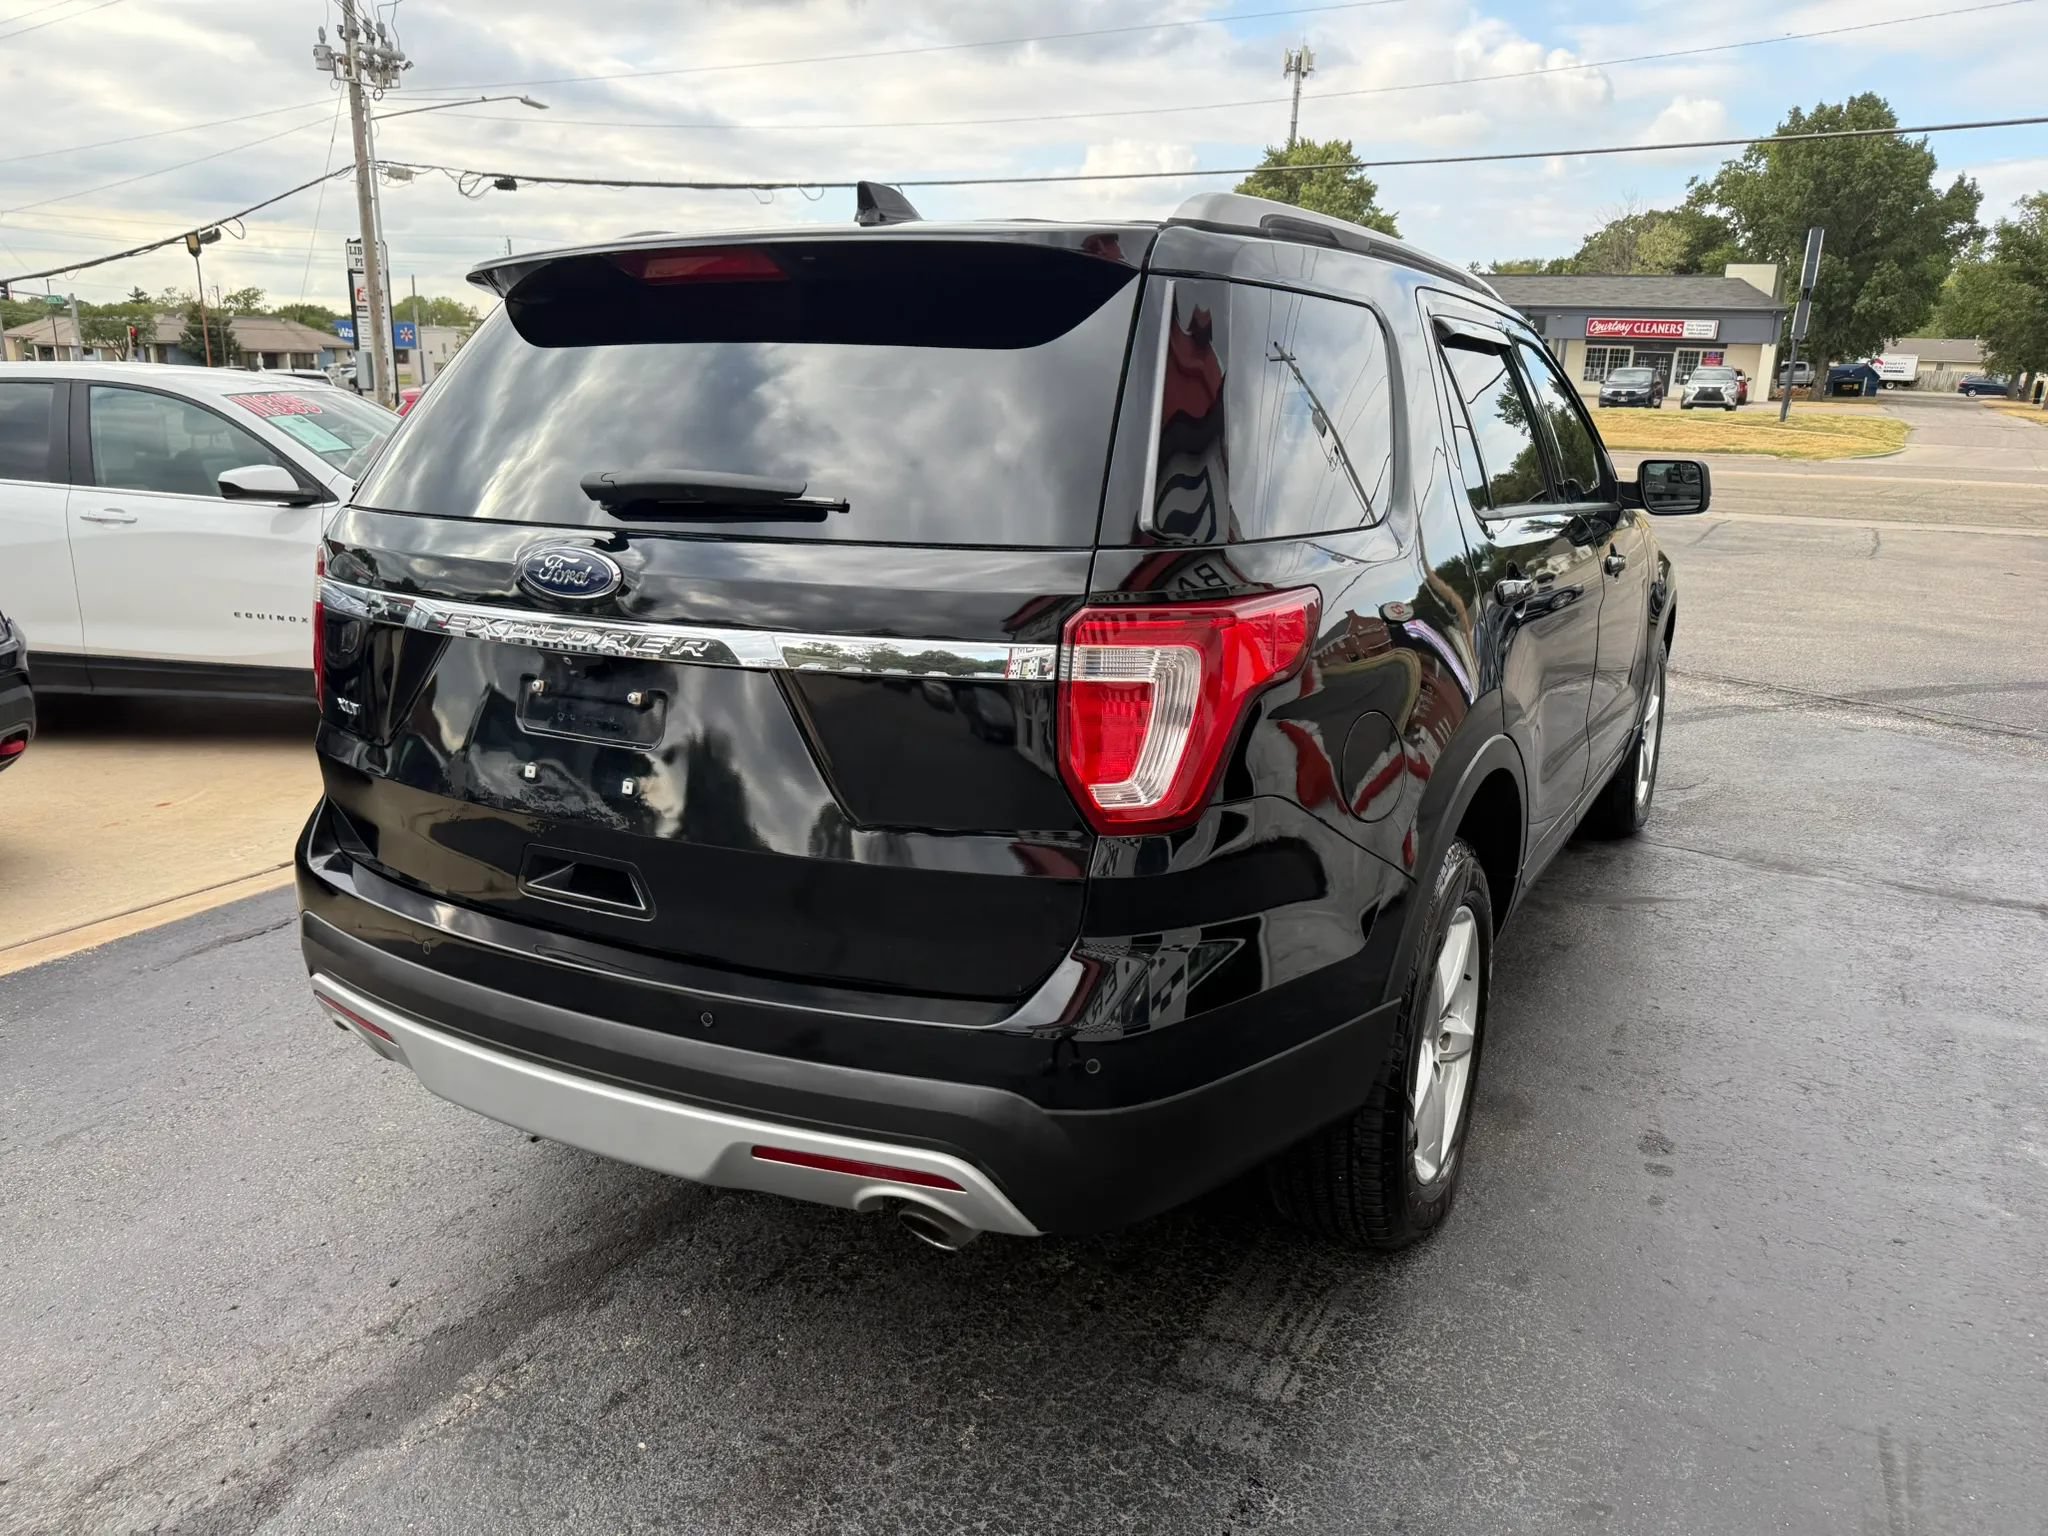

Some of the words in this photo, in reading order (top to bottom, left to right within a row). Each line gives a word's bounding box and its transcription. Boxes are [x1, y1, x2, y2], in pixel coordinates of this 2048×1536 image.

[1590, 321, 1632, 336] Courtesy
[1634, 322, 1682, 334] CLEANERS
[539, 554, 593, 586] Ford
[233, 611, 309, 623] EQUINOX
[442, 612, 711, 657] EXPLORER
[337, 697, 361, 716] XLT
